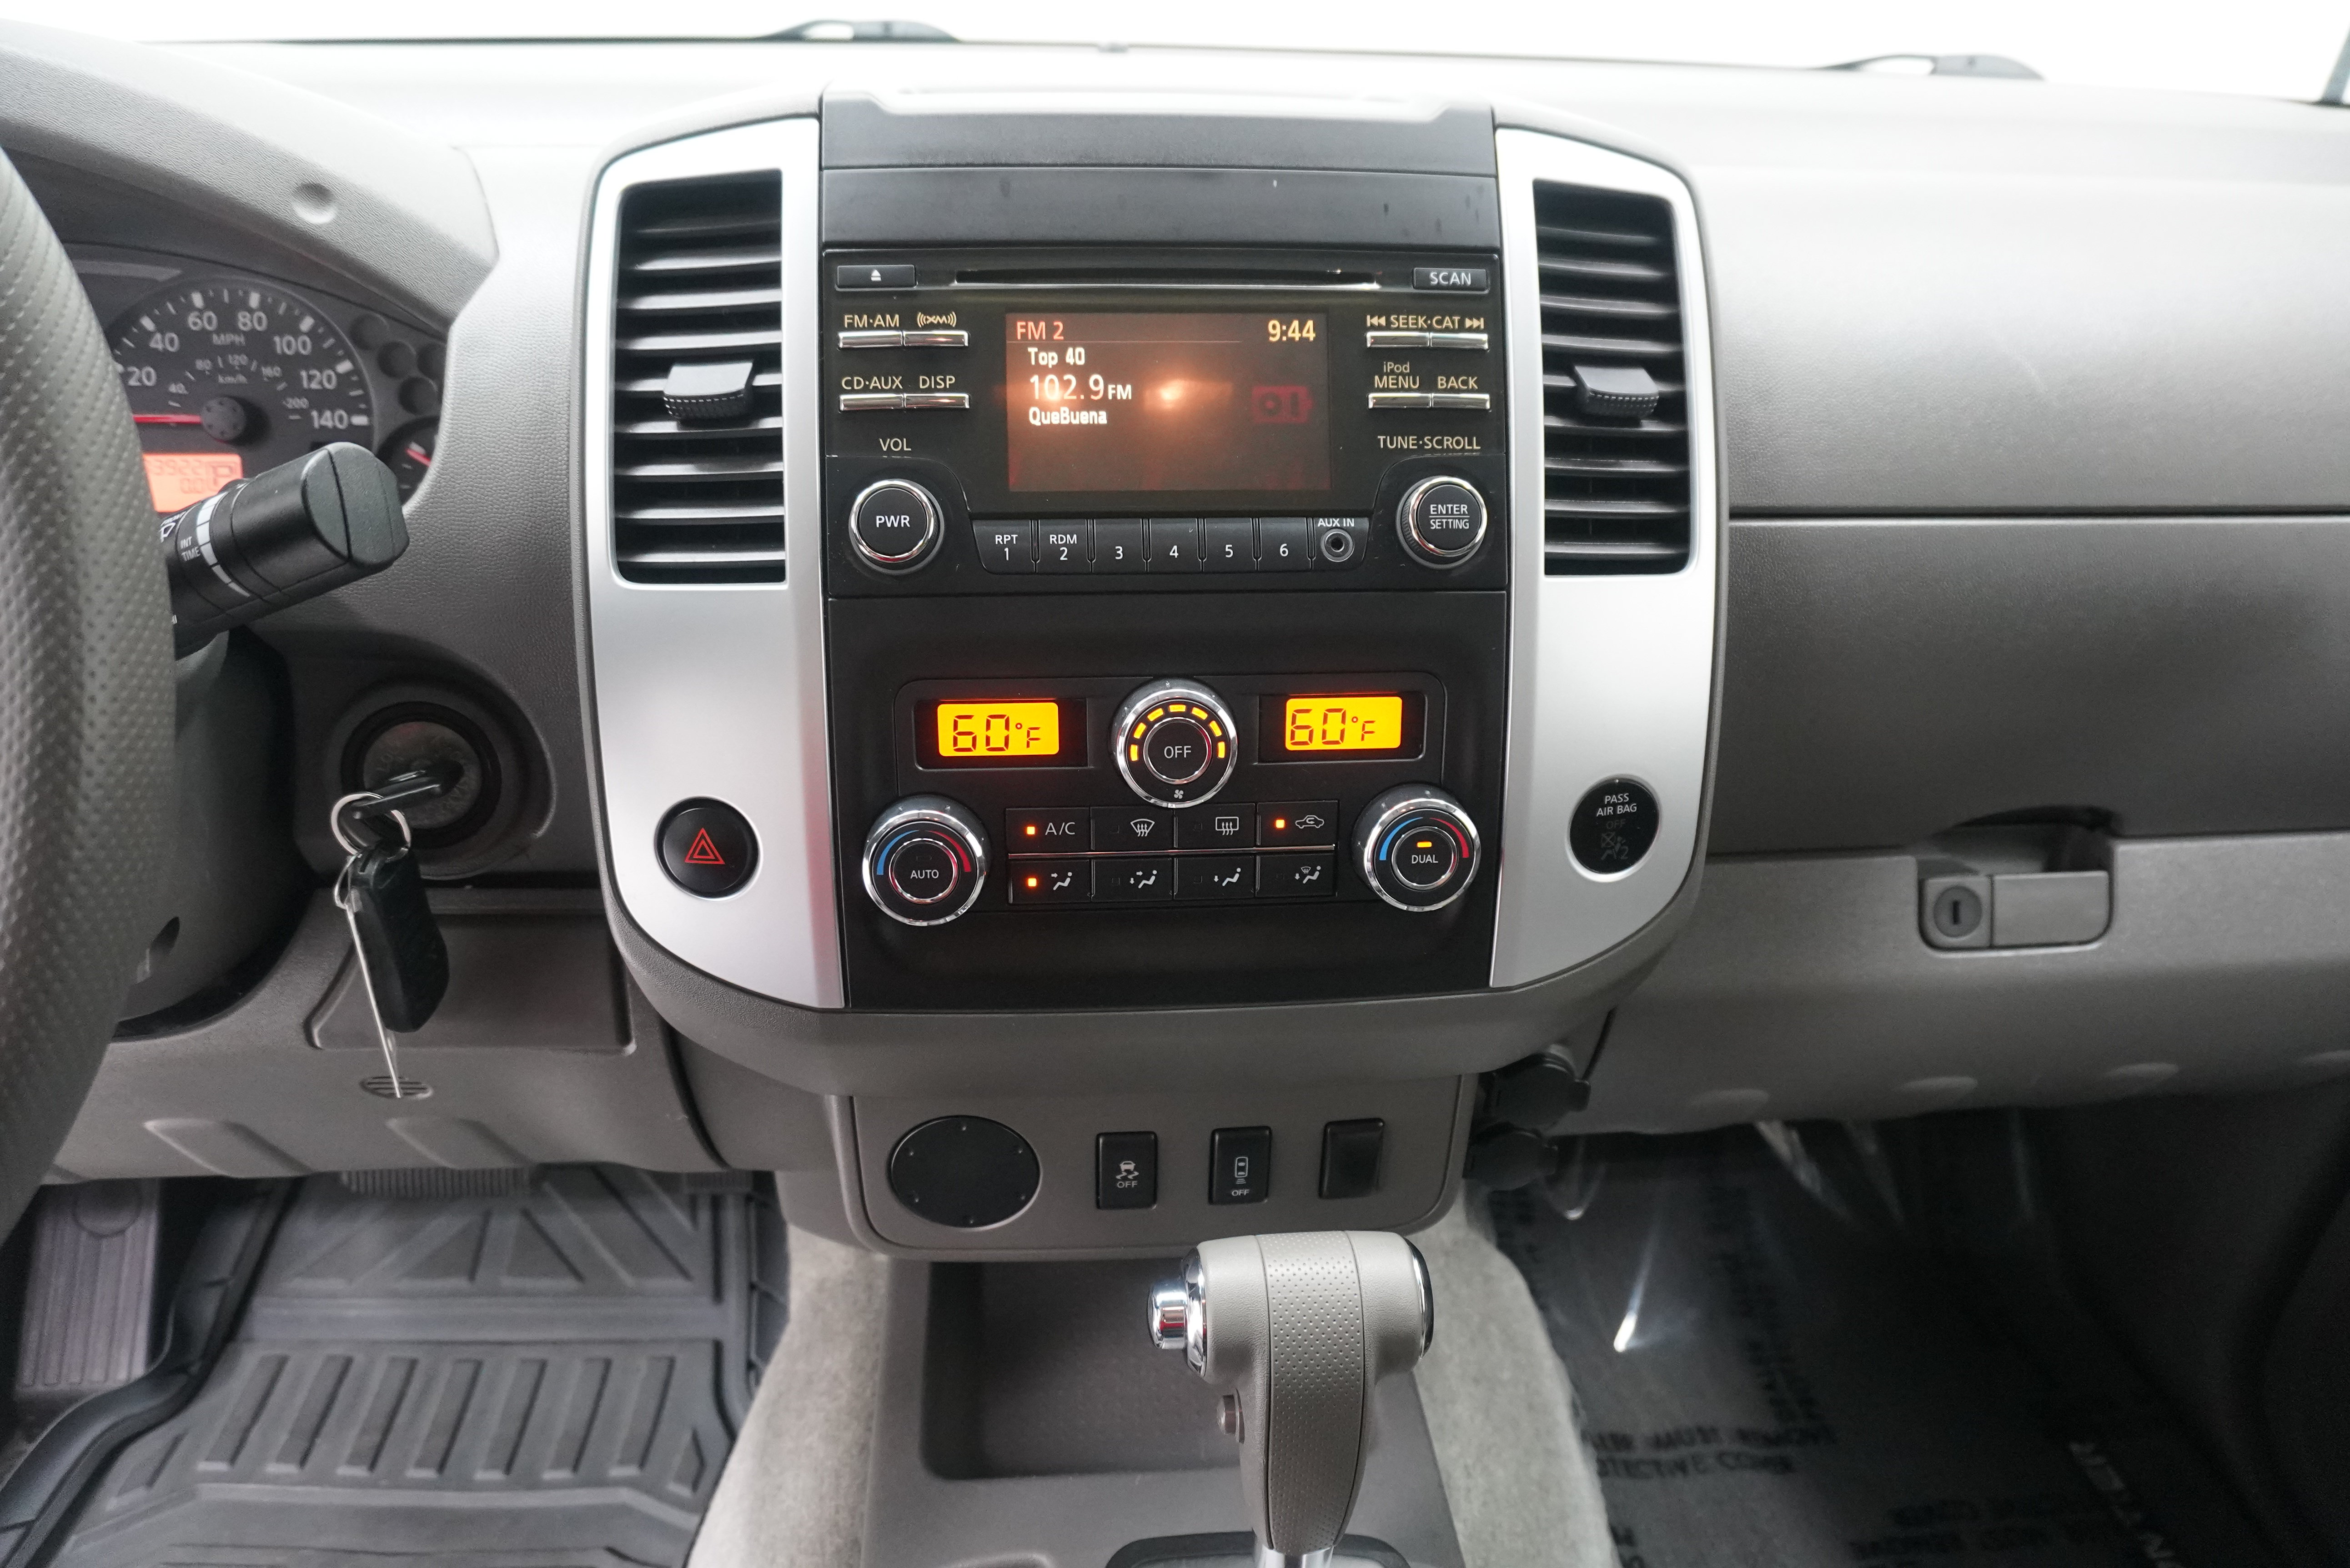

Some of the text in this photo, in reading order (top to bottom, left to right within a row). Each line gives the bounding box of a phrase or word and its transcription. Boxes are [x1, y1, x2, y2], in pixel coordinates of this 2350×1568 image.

[1429, 272, 1471, 285] SCAN
[187, 311, 217, 331] 60
[237, 311, 268, 332] 80
[1016, 321, 1064, 340] FM 2
[1267, 320, 1316, 342] 9:44
[149, 332, 180, 352] 40
[212, 333, 246, 346] MPH
[273, 335, 312, 356] 100
[1028, 347, 1085, 367] Top 40
[1383, 362, 1410, 373] iPod
[127, 366, 156, 386] 20
[300, 369, 337, 390] 120
[919, 376, 955, 388] DISP
[1374, 376, 1420, 389] MENU
[1029, 375, 1132, 400] 102.9 FM
[1437, 377, 1478, 389] BACK
[311, 410, 349, 429] 140
[1029, 407, 1107, 426] QueBuena
[879, 438, 911, 451] VOL
[1430, 504, 1468, 515] ENTER
[876, 515, 910, 528] PWR
[1318, 518, 1355, 528] AUX IN
[1430, 518, 1469, 530] SETTING
[181, 536, 192, 549] INT
[995, 535, 1018, 544] RPT
[1049, 534, 1077, 544] RDM
[181, 546, 201, 562] TIME
[1004, 548, 1009, 560] 1
[1060, 548, 1068, 560] 2
[1115, 547, 1123, 559] 3
[1169, 546, 1179, 558] 4
[1225, 545, 1234, 557] 5
[1280, 544, 1288, 556] 6
[1164, 745, 1191, 759] OFF
[1604, 792, 1630, 804] PASS
[1595, 802, 1637, 818] AIR BAG
[1045, 822, 1076, 835] A/C
[1606, 818, 1627, 830] OFF
[1411, 854, 1438, 864] DUAL
[910, 869, 939, 879] AUTO
